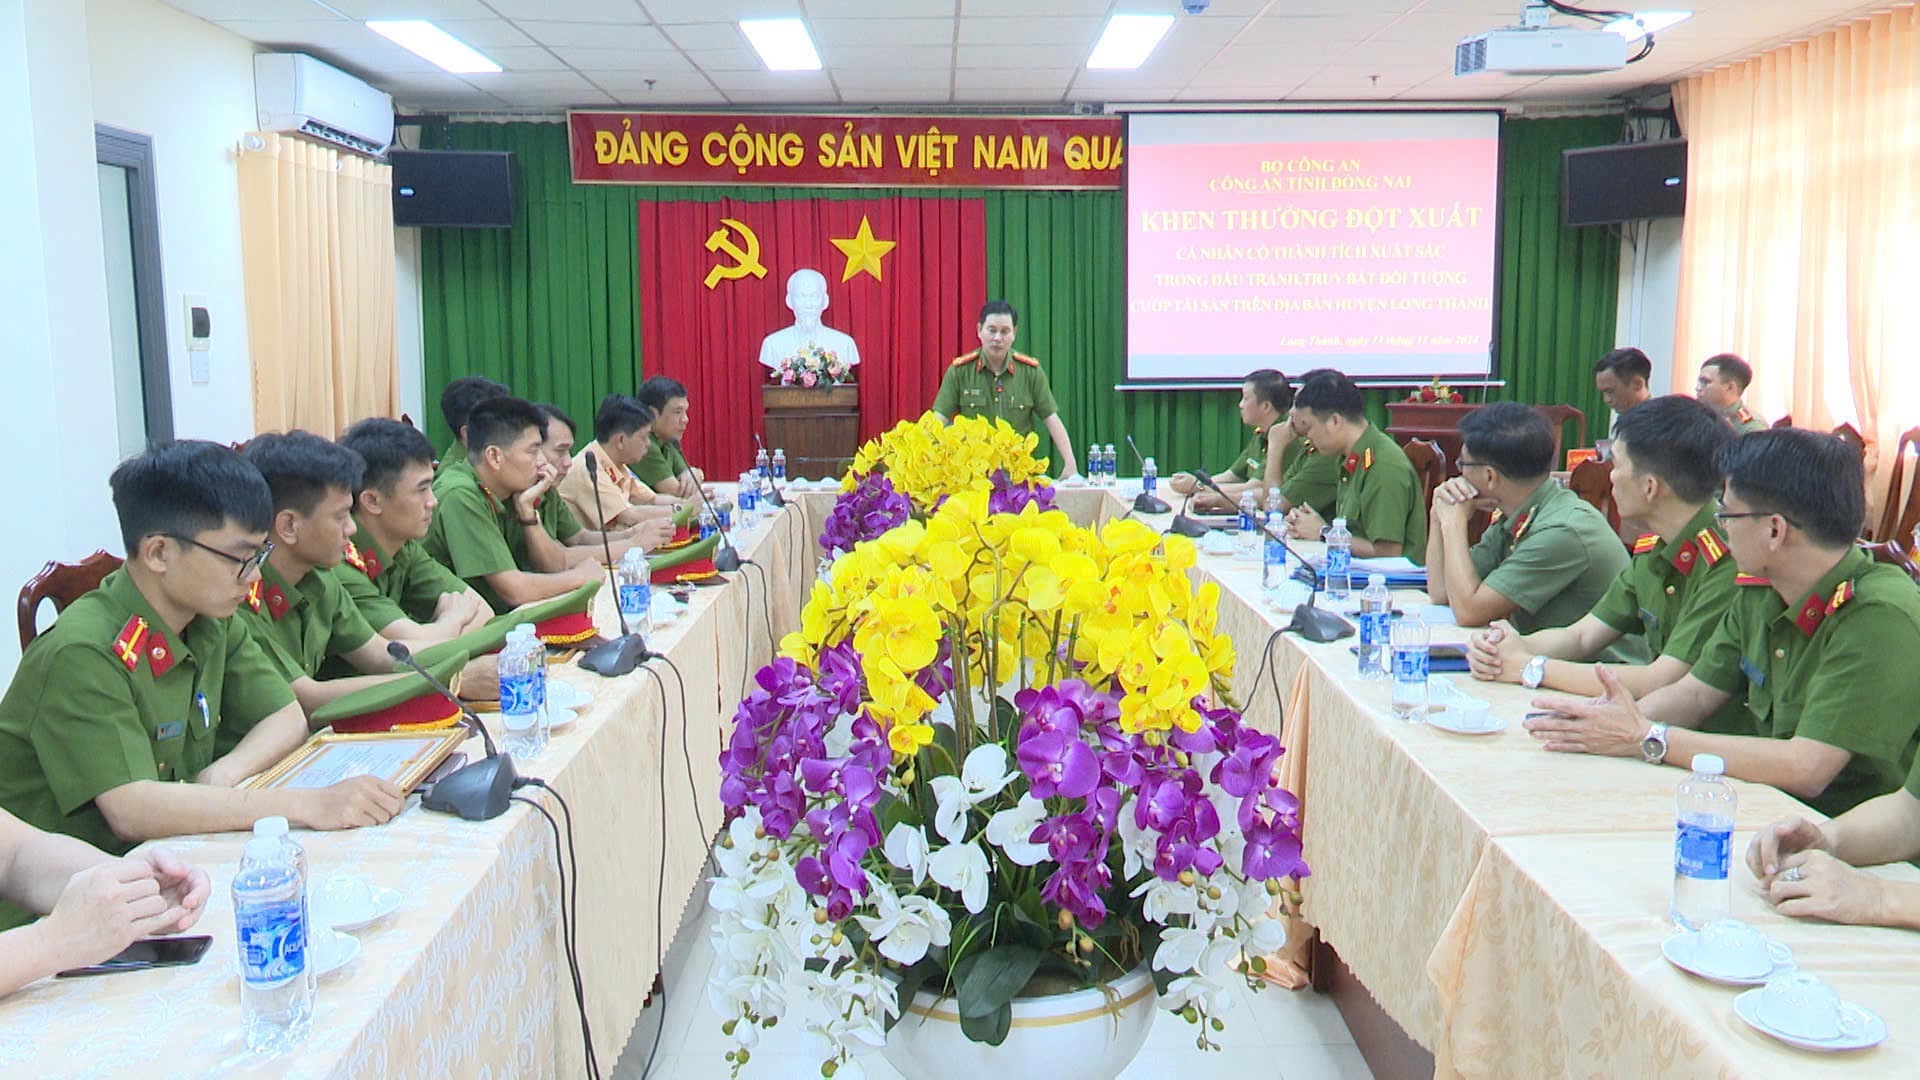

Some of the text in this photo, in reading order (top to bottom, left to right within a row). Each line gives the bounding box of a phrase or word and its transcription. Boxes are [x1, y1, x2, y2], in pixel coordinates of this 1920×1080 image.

[595, 118, 689, 165] ĐẢNG
[702, 123, 804, 174] CỘNG
[818, 121, 882, 168] SẢN
[896, 126, 958, 176] VIỆT
[973, 135, 1048, 169] NAM
[1287, 156, 1334, 173] CÔNG
[1338, 160, 1360, 173] AN
[1209, 176, 1256, 192] CÔNG
[1262, 178, 1282, 192] AN
[1383, 176, 1412, 190] NAI
[1142, 201, 1483, 234] KHEN THƯỞNG ĐỘT XUẤT
[1155, 273, 1208, 287] TRONG
